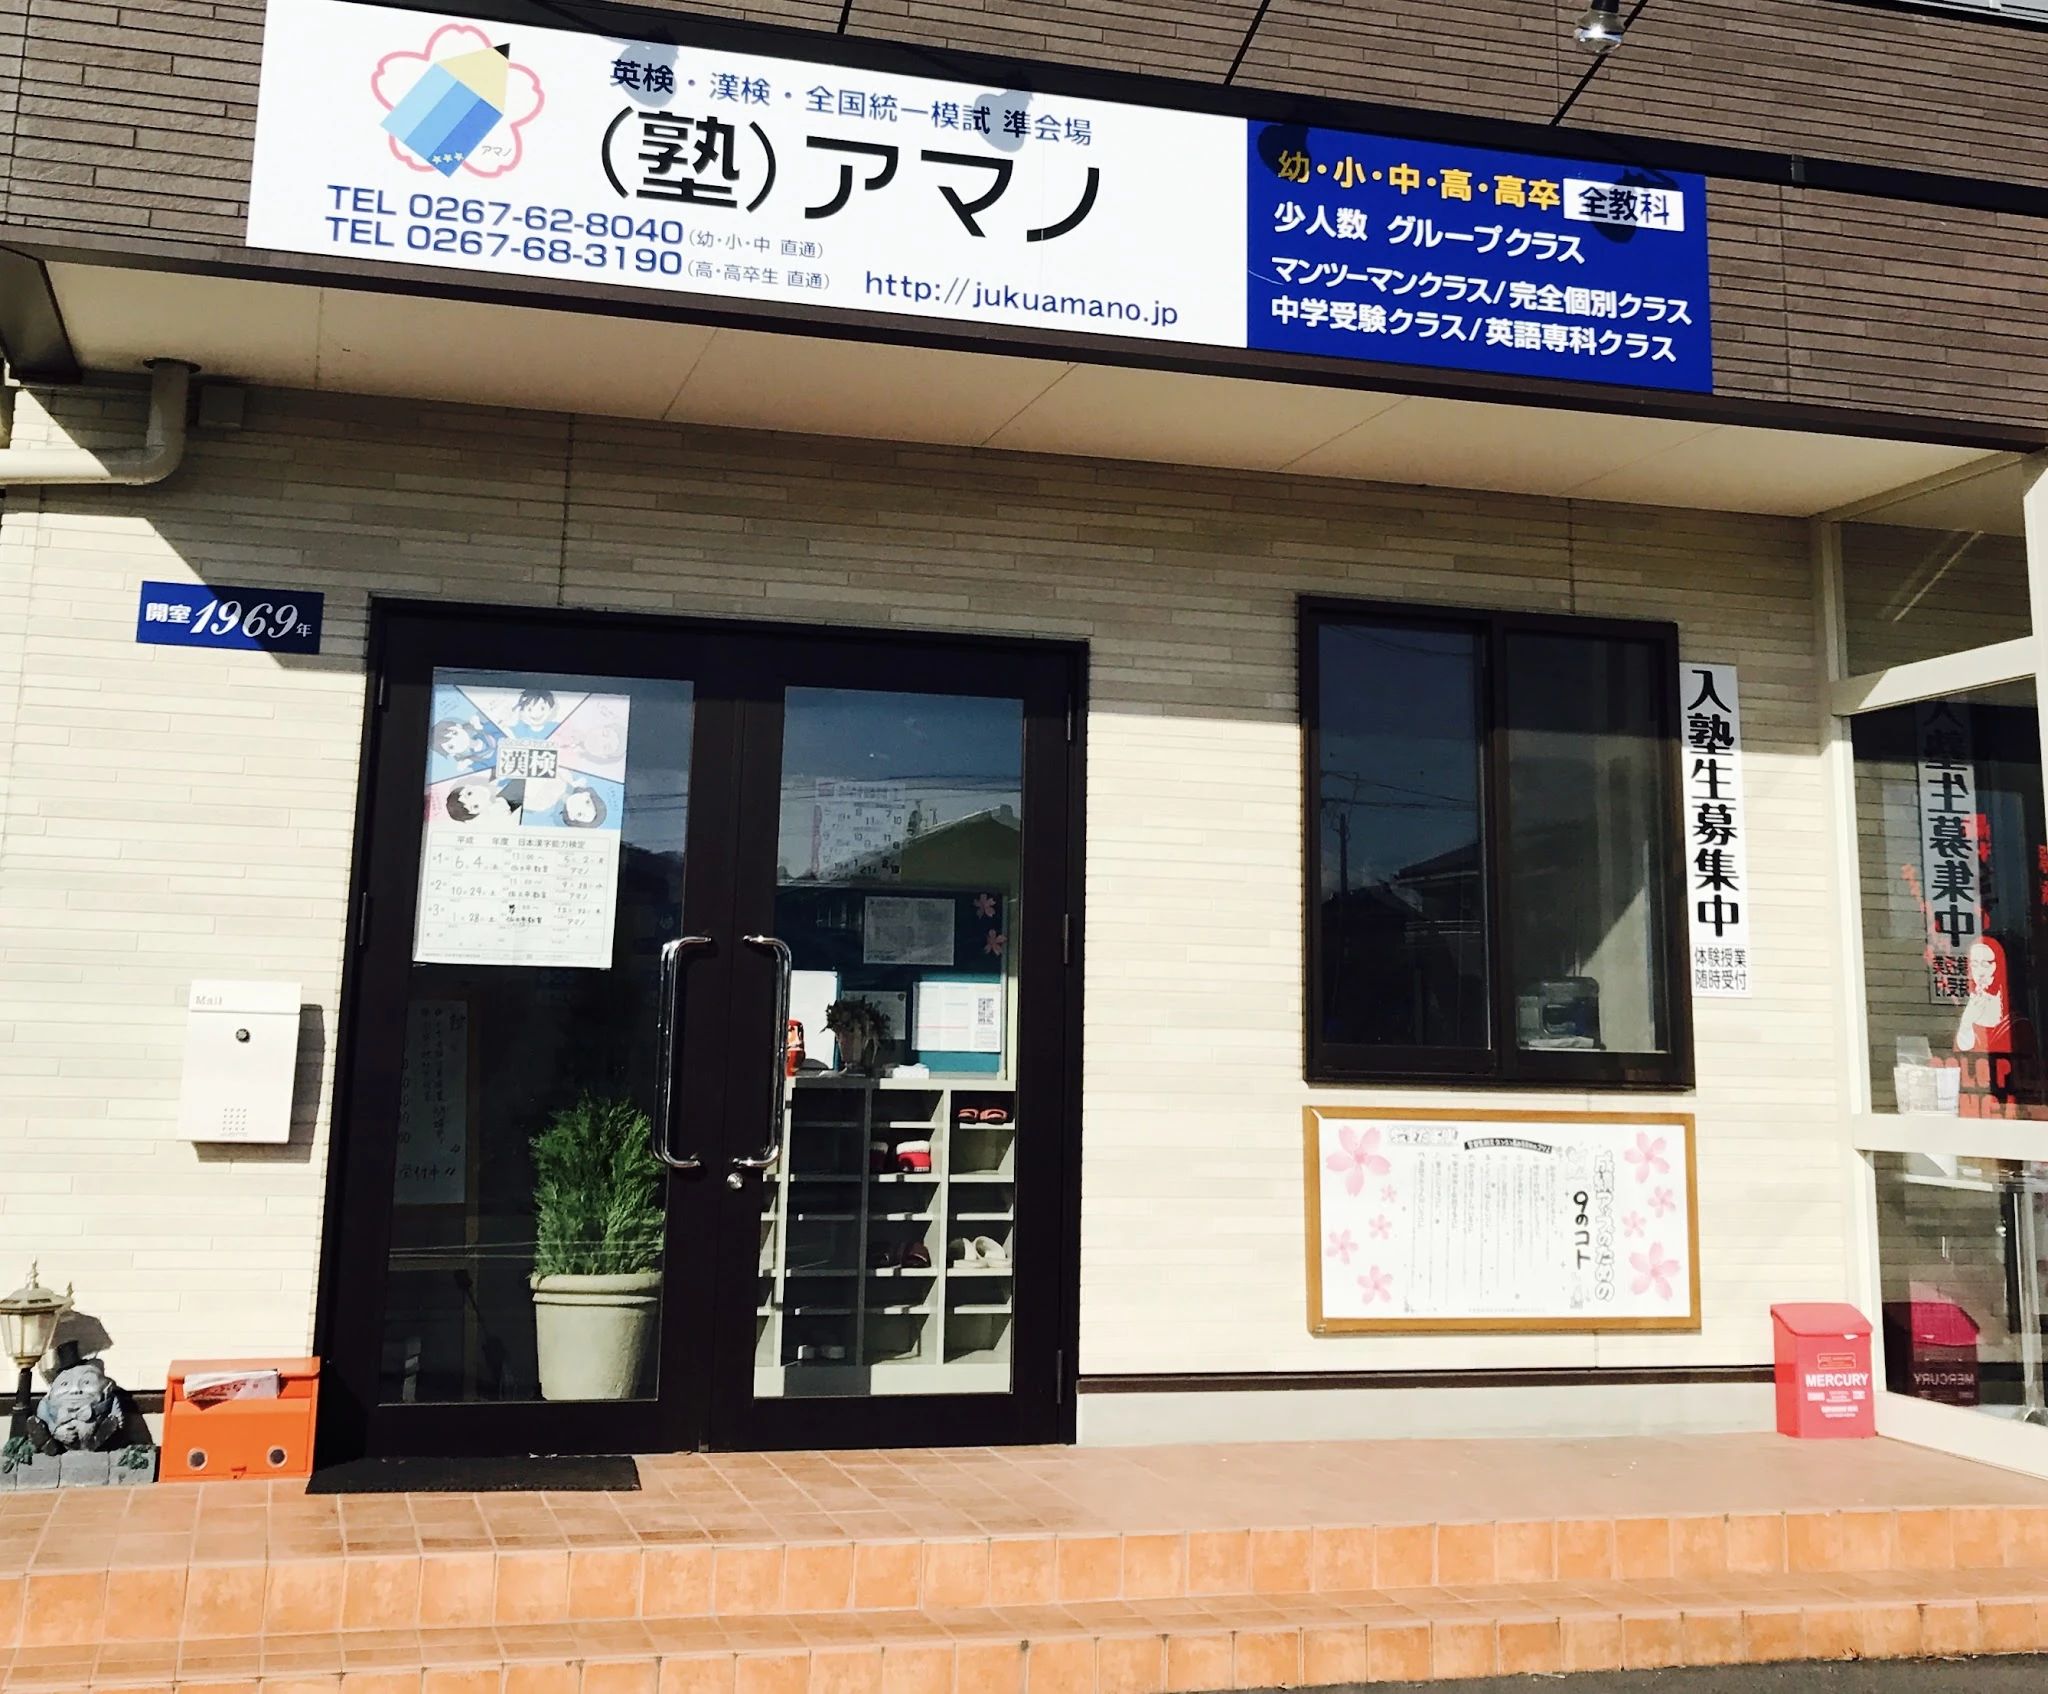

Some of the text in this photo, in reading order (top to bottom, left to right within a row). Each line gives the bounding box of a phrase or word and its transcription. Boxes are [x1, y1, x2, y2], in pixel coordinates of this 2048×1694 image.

[610, 59, 1093, 146] 英検・漢検・全国統一模試 準会場
[481, 145, 513, 157] アマノ
[327, 184, 684, 245] TEL 0267-62-8040
[1277, 149, 1670, 227] 幼・小・中・高・高卒 全教科
[325, 217, 683, 276] TEL 0267-68-3190
[1273, 201, 1586, 264] 少人数 グループクラス
[865, 271, 1179, 328] http://jukuamano.jp
[501, 749, 557, 778] 漢検
[1686, 669, 1740, 938] 入塾生募集中
[1694, 946, 1748, 968] 体験授業
[1694, 968, 1748, 991] 随時受付
[195, 994, 224, 1006] Mail
[1805, 1373, 1869, 1388] MERCURY
